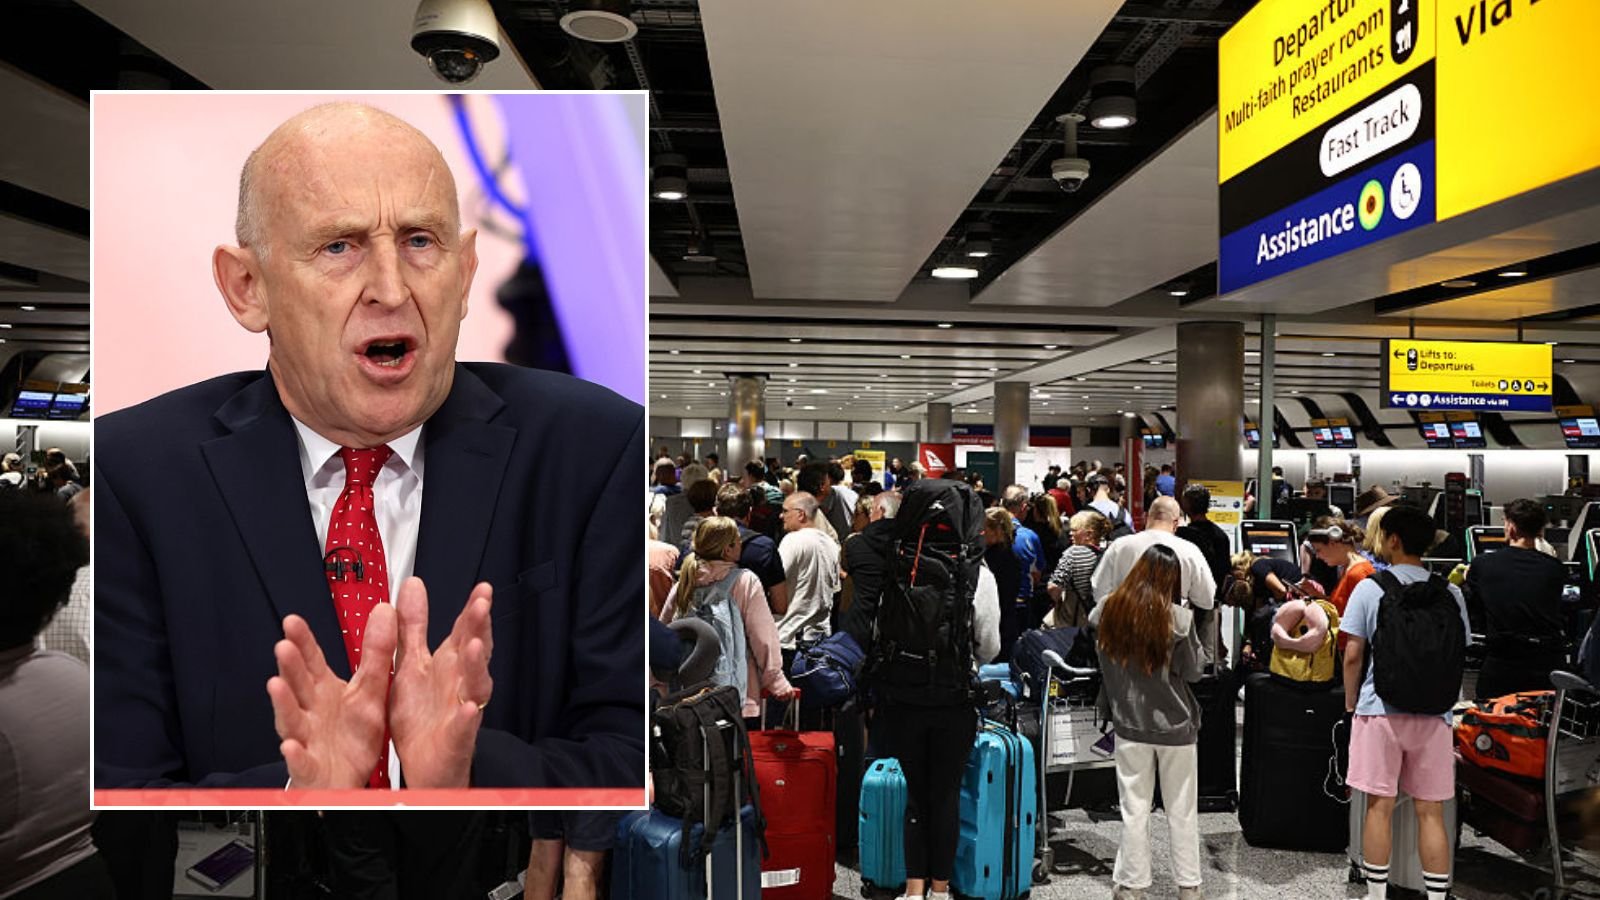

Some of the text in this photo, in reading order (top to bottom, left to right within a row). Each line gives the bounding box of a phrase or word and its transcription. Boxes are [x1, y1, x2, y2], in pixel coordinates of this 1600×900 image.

[1225, 7, 1384, 134] Multi-faith prayer room
[1292, 44, 1384, 119] Restaurants
[1328, 99, 1409, 162] Fast Track
[1256, 203, 1355, 265] Assistance
[1420, 349, 1457, 360] Lifts to:
[1420, 361, 1475, 372] Departures
[1433, 393, 1486, 405] Assistance
[1471, 379, 1496, 388] Toilets
